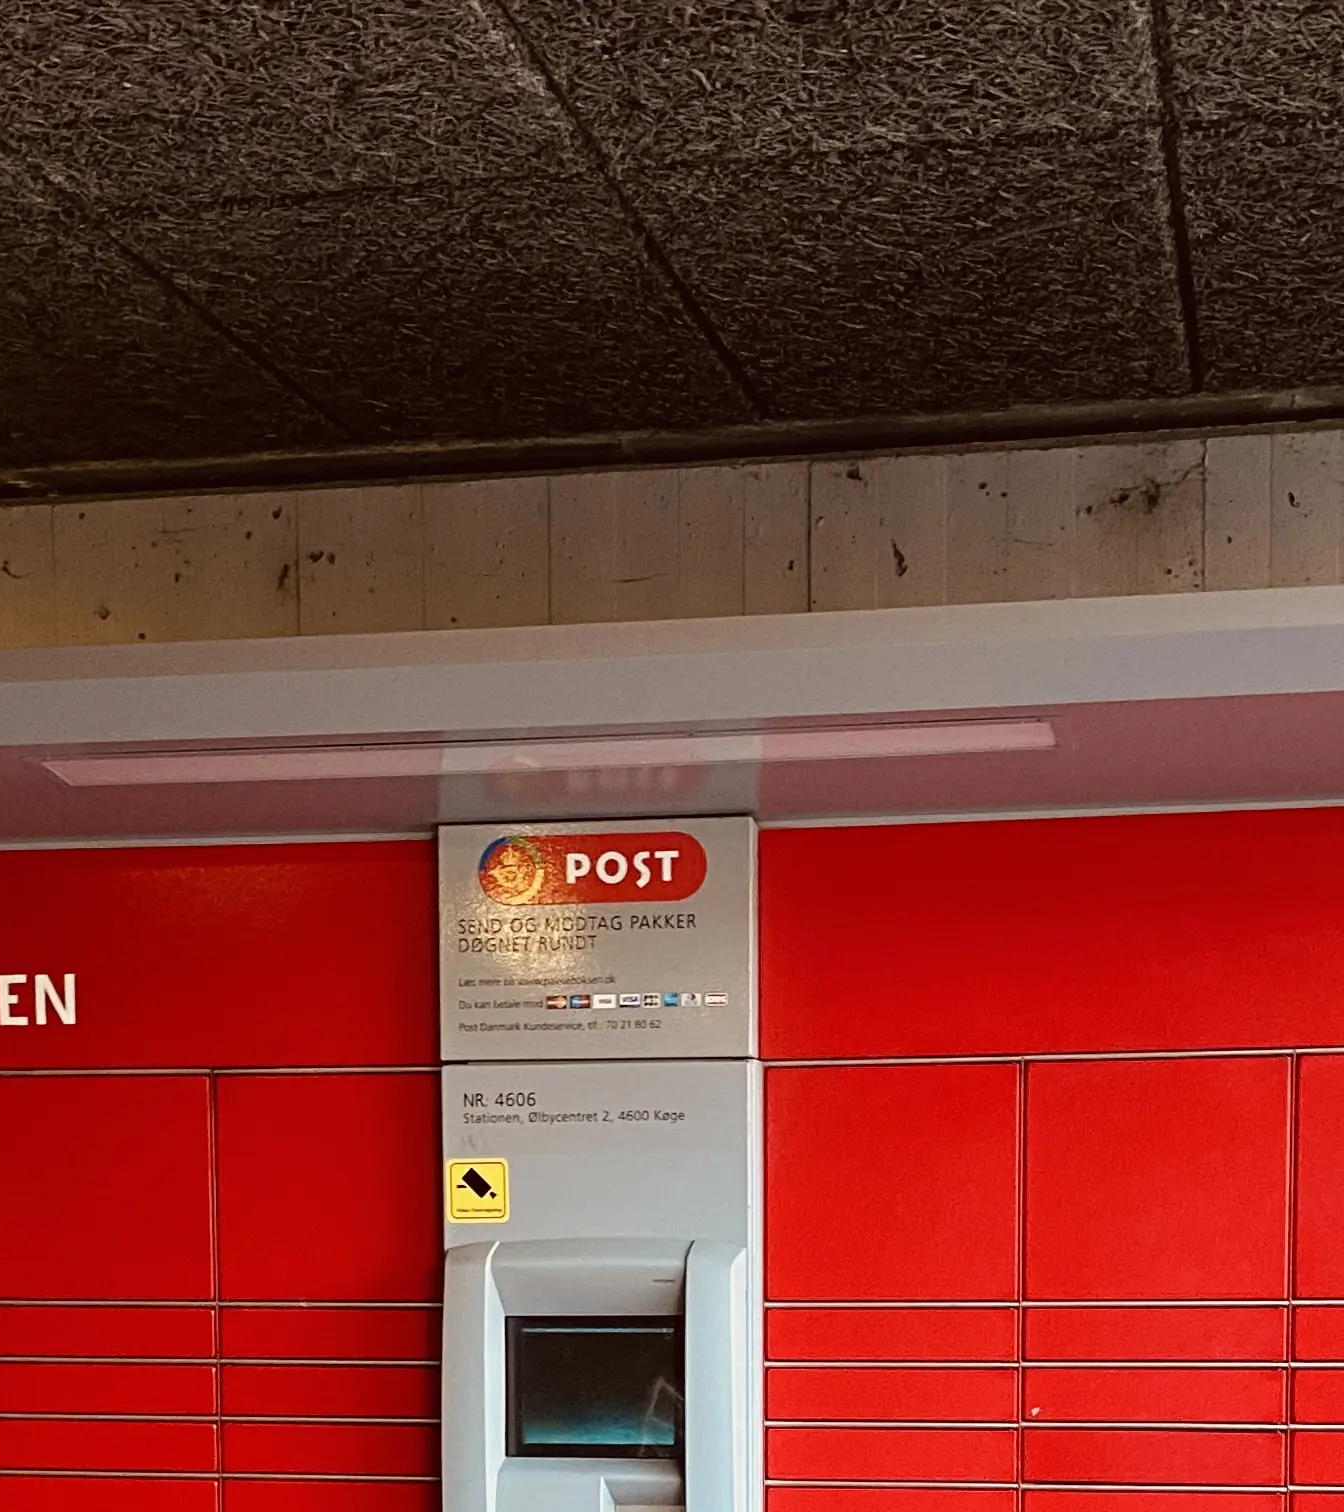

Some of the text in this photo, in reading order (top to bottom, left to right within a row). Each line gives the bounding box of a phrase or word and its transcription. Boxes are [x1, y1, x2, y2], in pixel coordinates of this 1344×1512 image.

[566, 850, 680, 889] POST
[458, 913, 697, 935] SEND OG MODTAG PAKKER
[458, 934, 598, 952] DØGNET RUNDT
[458, 999, 472, 1010] Du
[458, 1022, 478, 1033] Post
[479, 1021, 521, 1032] Danmark
[494, 1092, 537, 1107] 4606
[462, 1112, 525, 1125] Stationen,
[528, 1111, 598, 1125] Ølbycentret
[617, 1109, 650, 1121] 4600
[653, 1109, 686, 1124] Køge
